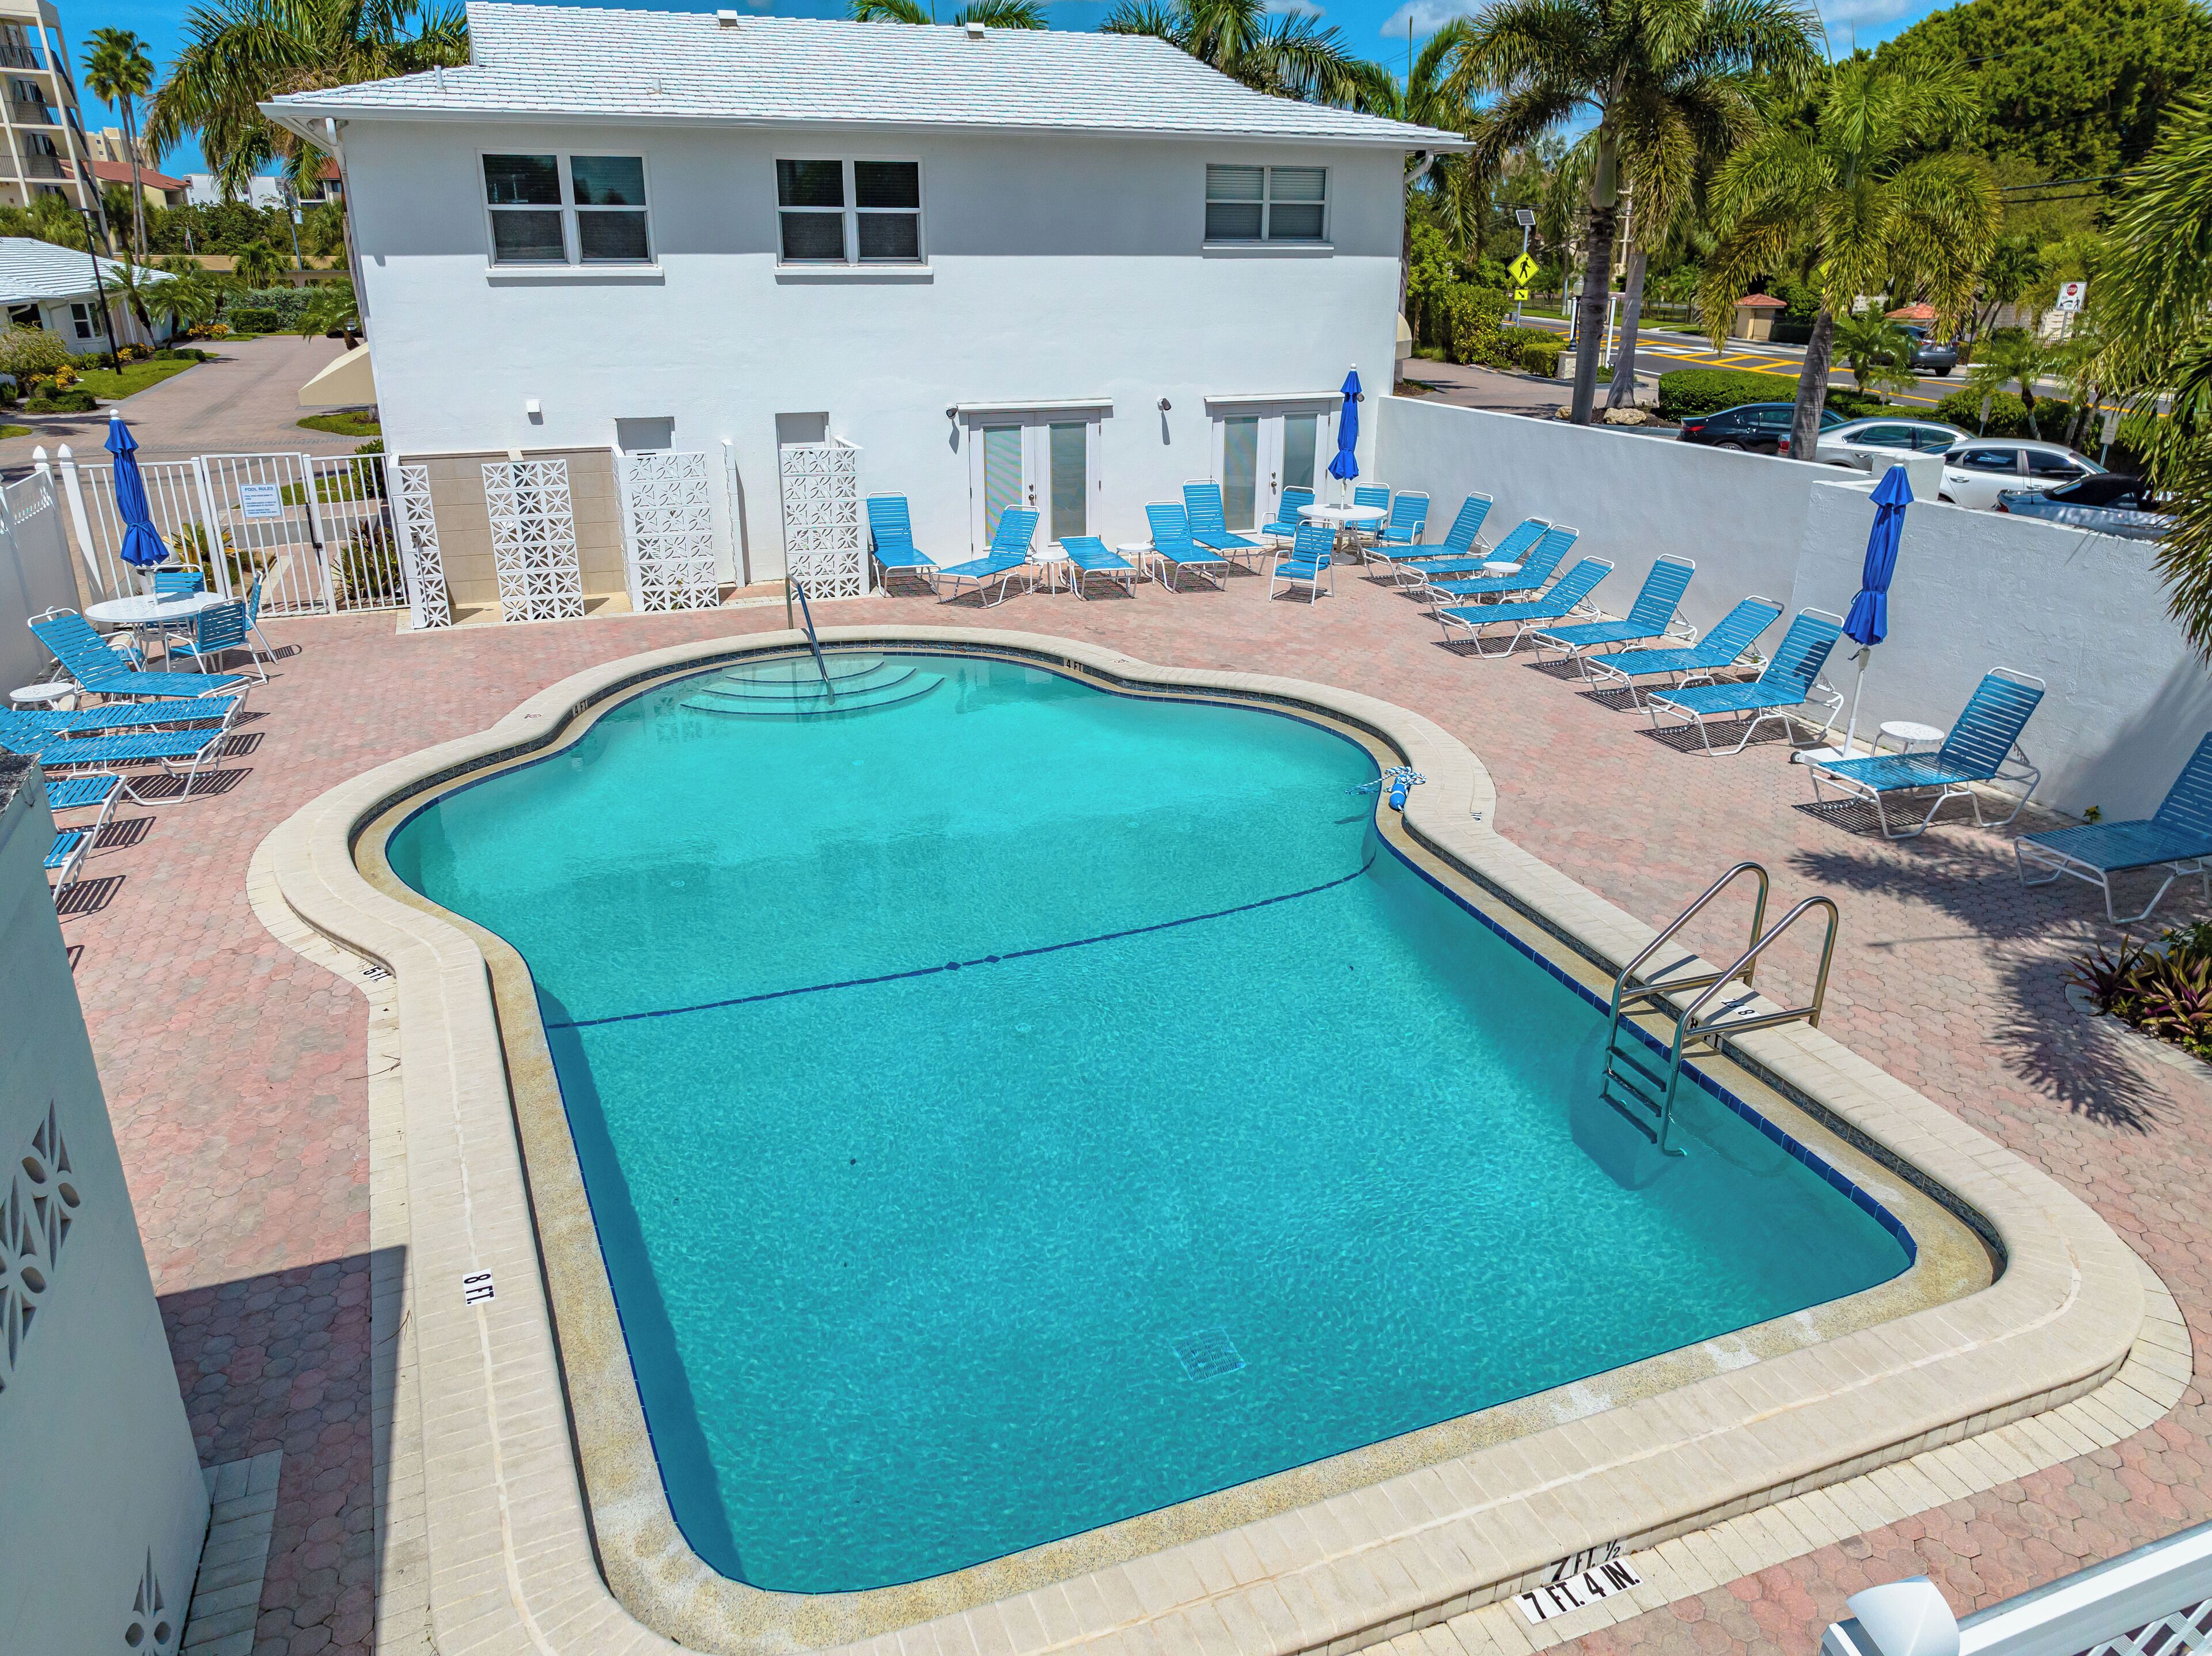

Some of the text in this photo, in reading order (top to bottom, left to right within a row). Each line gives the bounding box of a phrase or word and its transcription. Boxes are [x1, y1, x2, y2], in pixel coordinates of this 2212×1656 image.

[1066, 659, 1082, 672] 4 FT
[575, 699, 587, 715] 4 FT
[363, 967, 393, 982] 5 FT.
[1721, 998, 1745, 1009] FT.
[464, 1274, 494, 1305] 8 FT.
[1551, 1555, 1571, 1583] 7
[1574, 1546, 1597, 1574] FT.
[1521, 1560, 1641, 1620] 7 FT. 4 IN.
